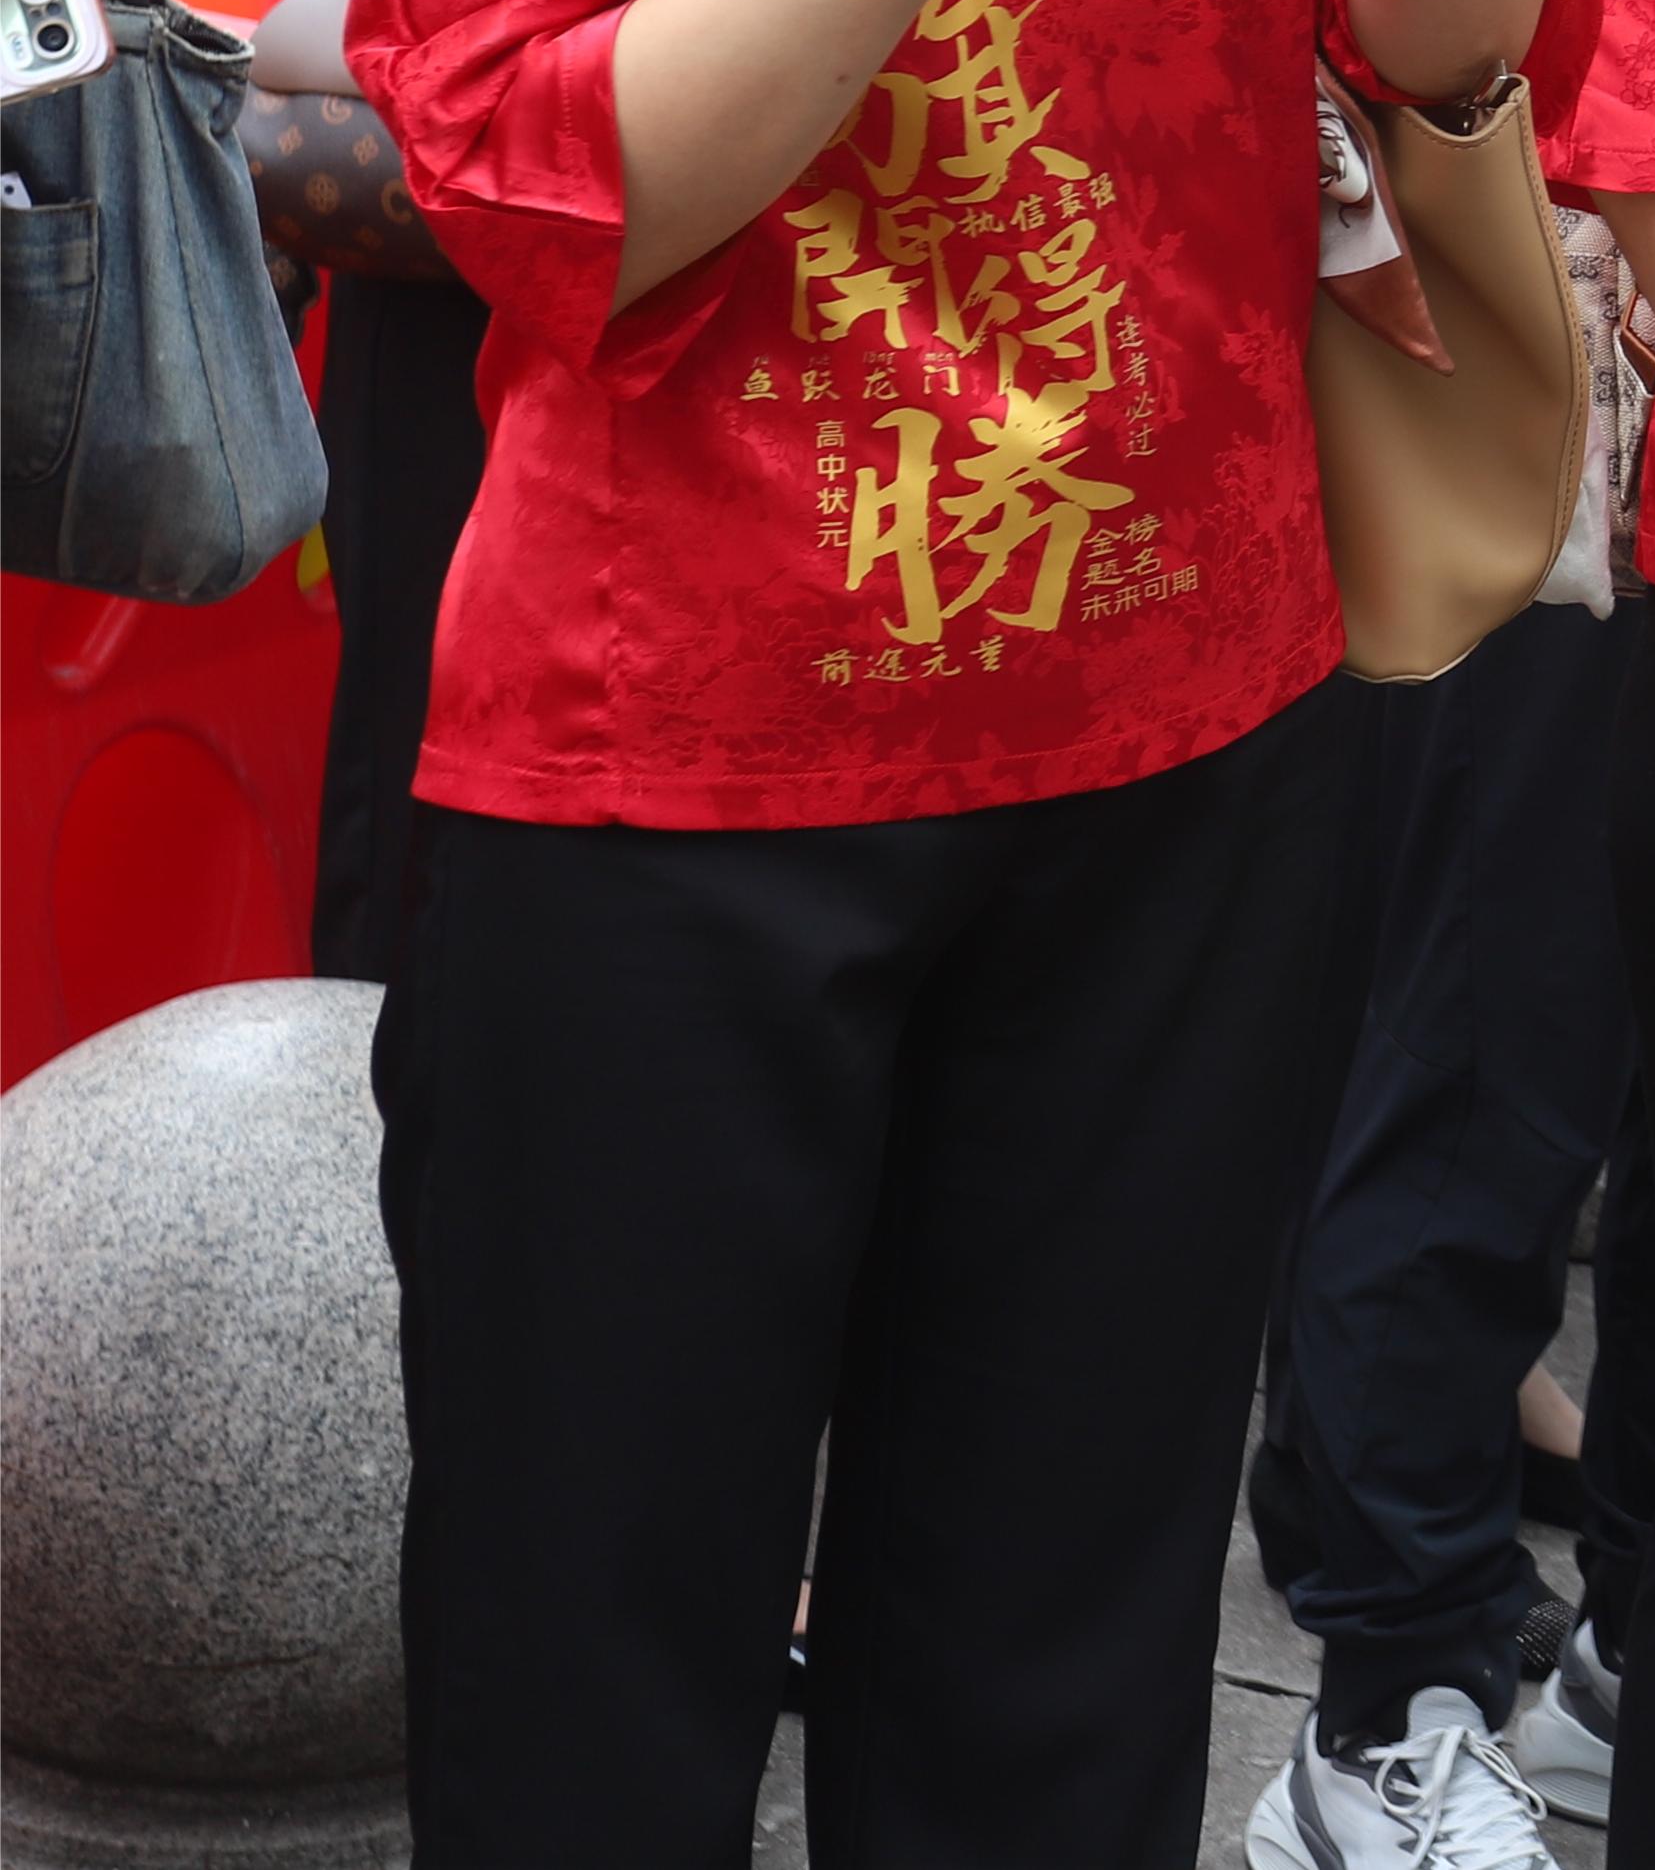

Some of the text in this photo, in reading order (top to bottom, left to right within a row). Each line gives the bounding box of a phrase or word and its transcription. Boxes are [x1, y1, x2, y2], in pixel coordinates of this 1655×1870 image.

[959, 172, 1116, 238] 执信最强
[739, 365, 961, 402] 鱼跃龙门
[1116, 315, 1158, 459] 逢考必过
[816, 420, 850, 549] 高中状元
[846, 387, 1135, 644] 勝
[1084, 514, 1162, 558] 金榜
[1081, 547, 1161, 591] 题名
[1081, 564, 1199, 622] 未来可期
